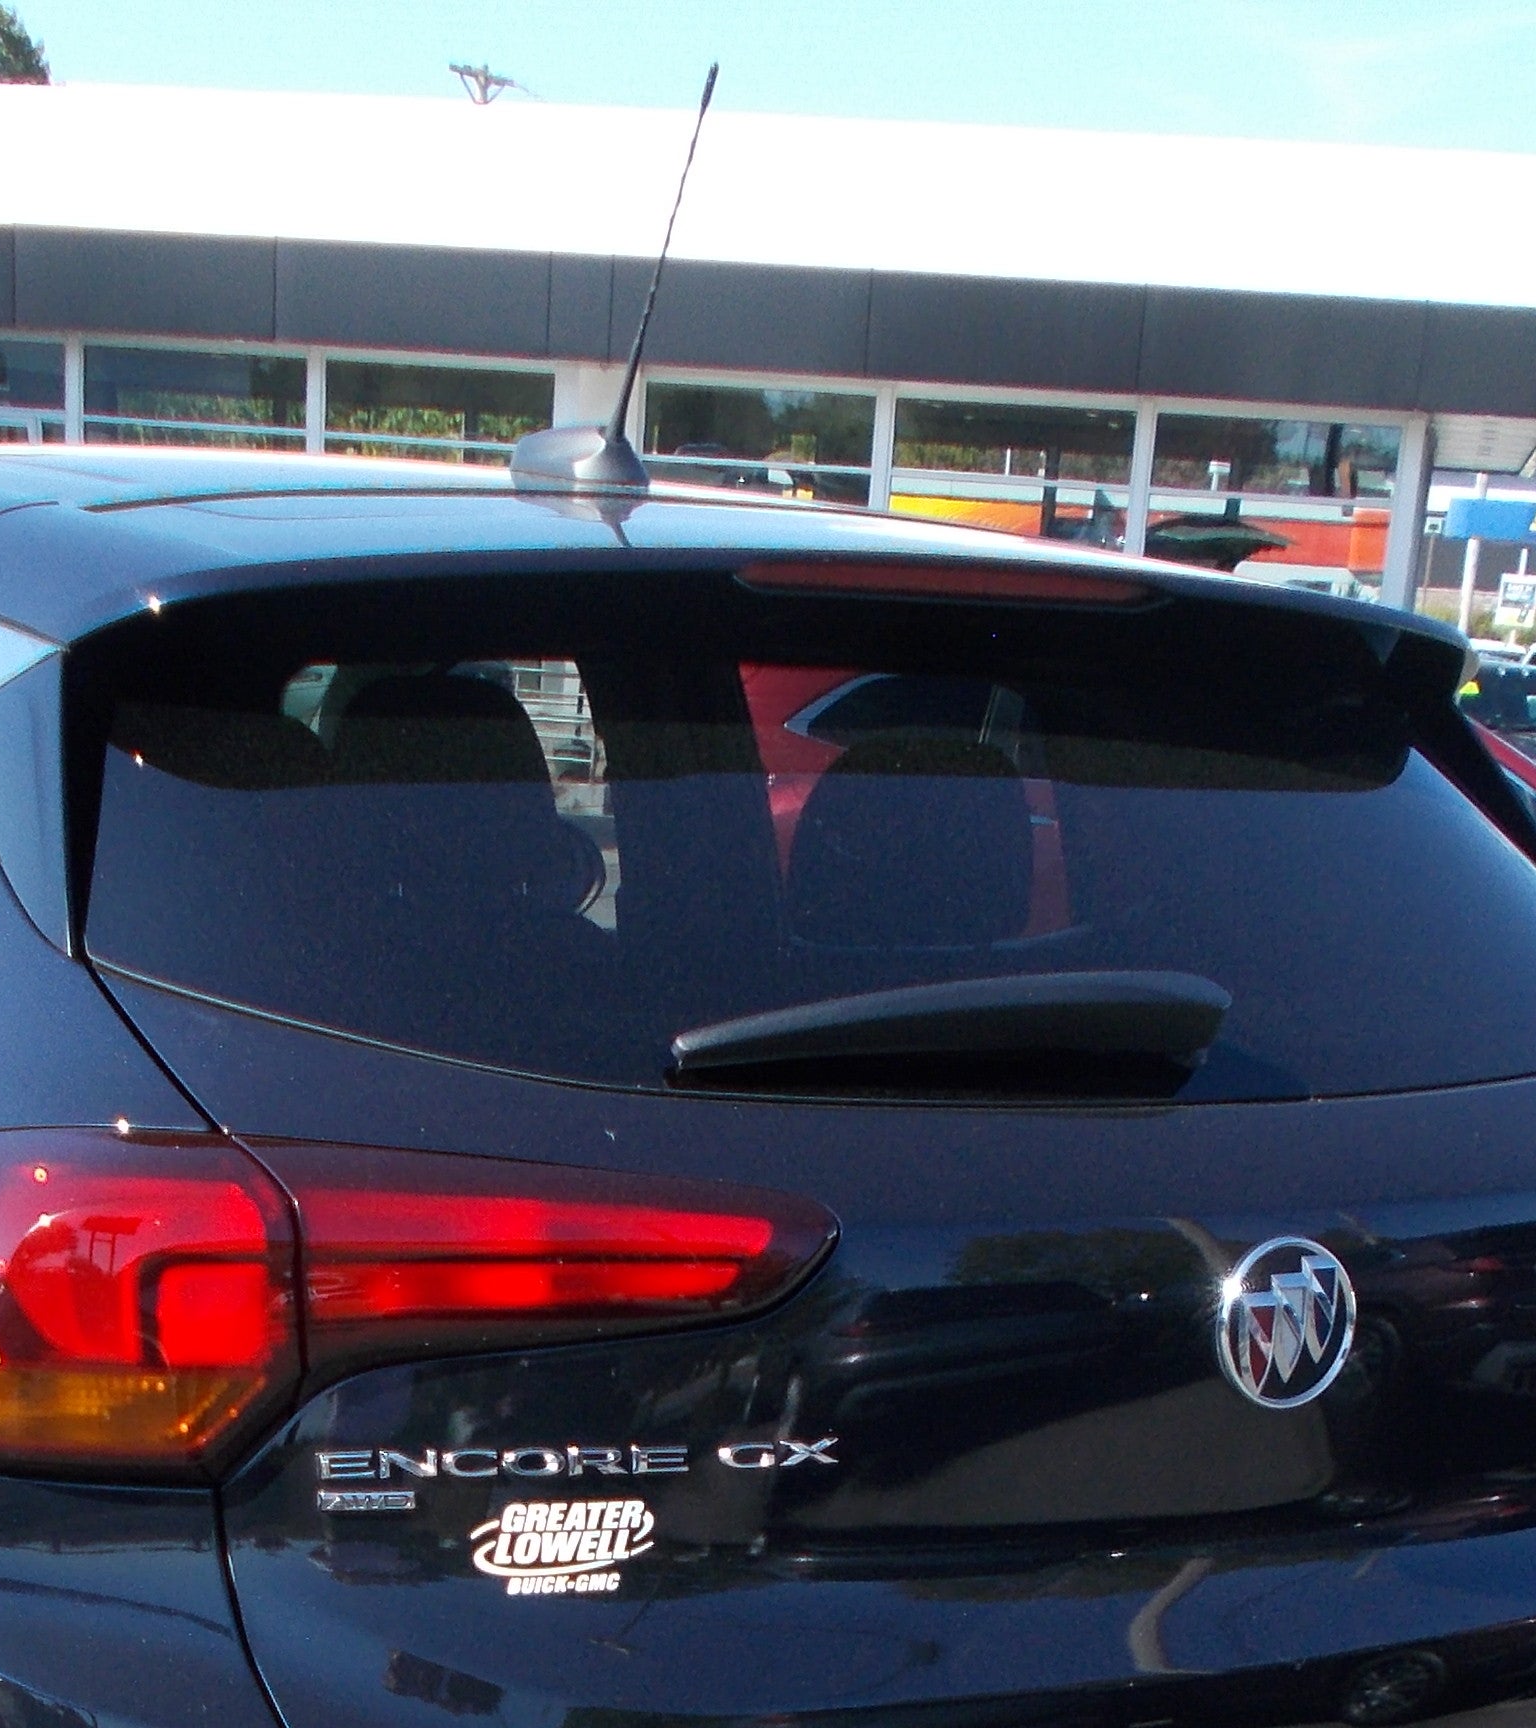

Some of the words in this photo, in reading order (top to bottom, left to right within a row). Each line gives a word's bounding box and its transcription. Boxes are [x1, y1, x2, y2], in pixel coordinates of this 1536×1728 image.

[315, 1446, 689, 1480] ENCORE
[718, 1437, 839, 1469] GX
[318, 1491, 416, 1511] AWD
[500, 1500, 645, 1533] GREATER
[493, 1529, 631, 1565] LOWELL
